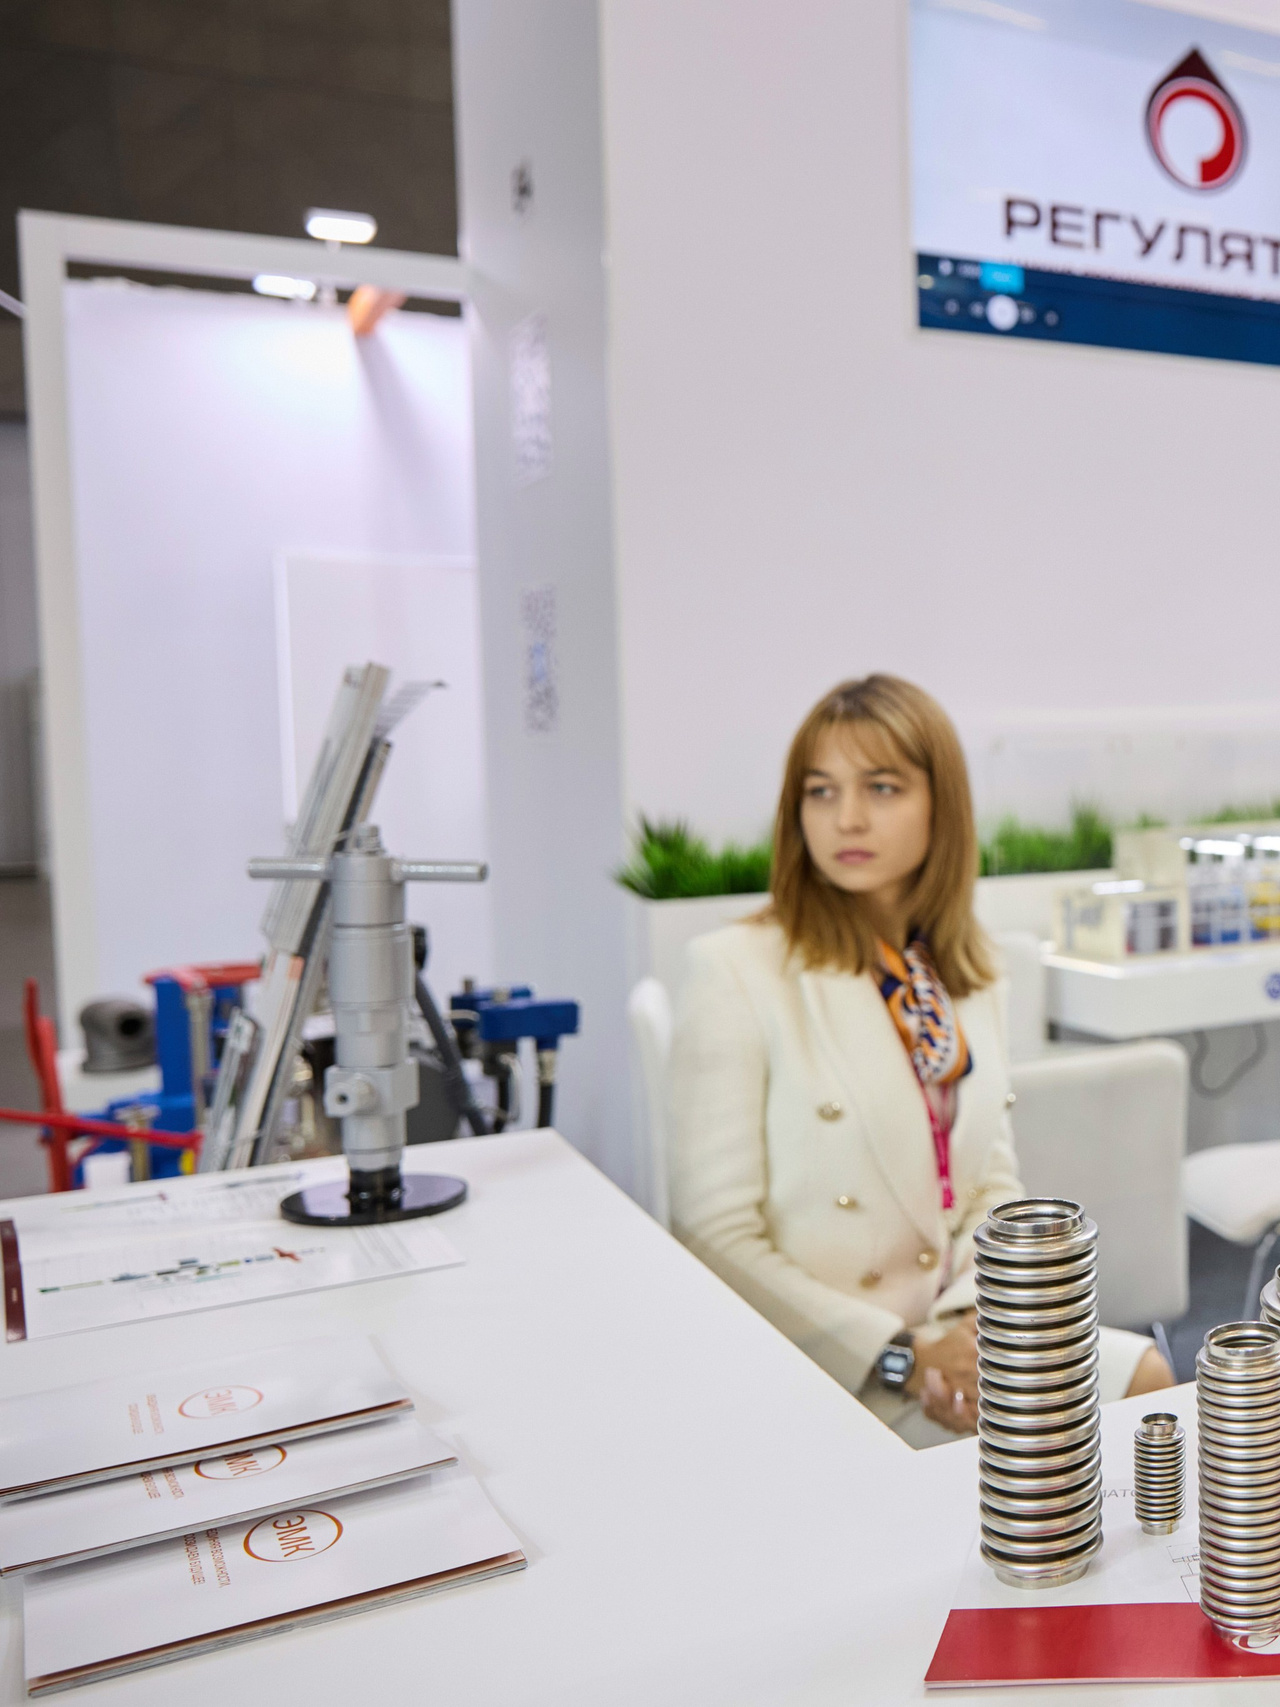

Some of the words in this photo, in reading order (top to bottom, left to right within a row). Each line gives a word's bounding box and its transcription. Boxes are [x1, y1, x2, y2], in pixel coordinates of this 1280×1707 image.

[202, 1388, 239, 1417] ЭМК
[223, 1449, 262, 1477] МК
[272, 1514, 316, 1558] ЭМК
